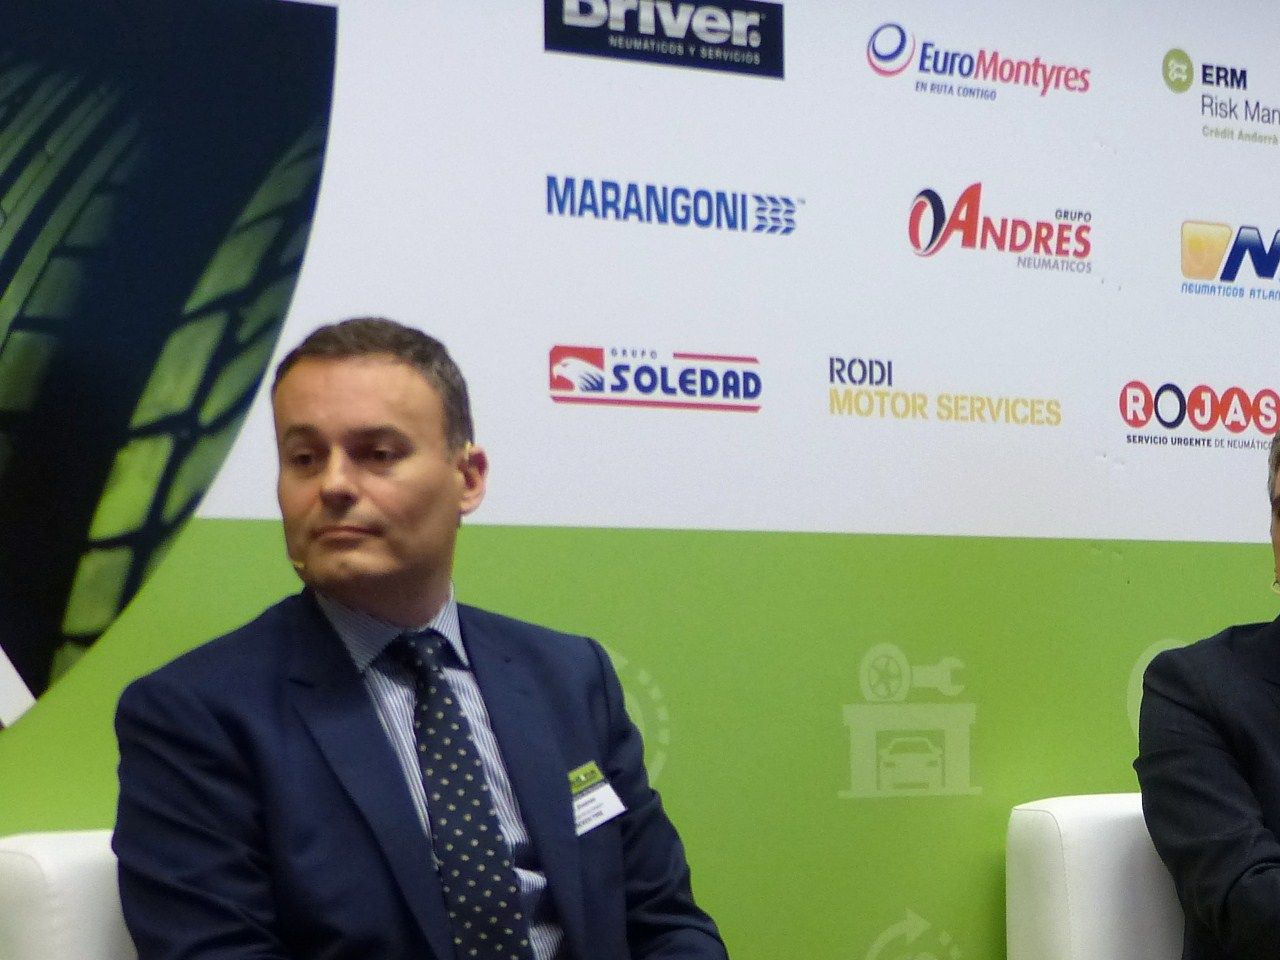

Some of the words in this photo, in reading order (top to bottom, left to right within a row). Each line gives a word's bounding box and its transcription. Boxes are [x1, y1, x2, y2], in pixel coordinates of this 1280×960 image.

[700, 47, 761, 65] SERVICIOS
[918, 41, 1091, 97] EuroMontyres
[1202, 64, 1247, 90] ERM
[915, 81, 927, 92] EN
[930, 83, 953, 95] RUTA
[956, 85, 997, 100] CONTIGO
[1201, 94, 1238, 120] Risk
[546, 175, 748, 232] MARANGONI
[1055, 208, 1092, 222] GRUPO
[1017, 257, 1092, 274] NEUMATICOS
[611, 348, 658, 360] GRUPO
[611, 364, 762, 400] SOLEDAD
[829, 357, 893, 387] RODI
[829, 388, 929, 420] MOTOR
[936, 392, 1062, 426] SERVICES
[1123, 382, 1279, 431] ROJAS
[1126, 434, 1168, 445] SERVICIO
[1171, 437, 1212, 448] URGENTE
[1214, 439, 1225, 449] DE
[1227, 438, 1272, 450] NEUMÁTICO
